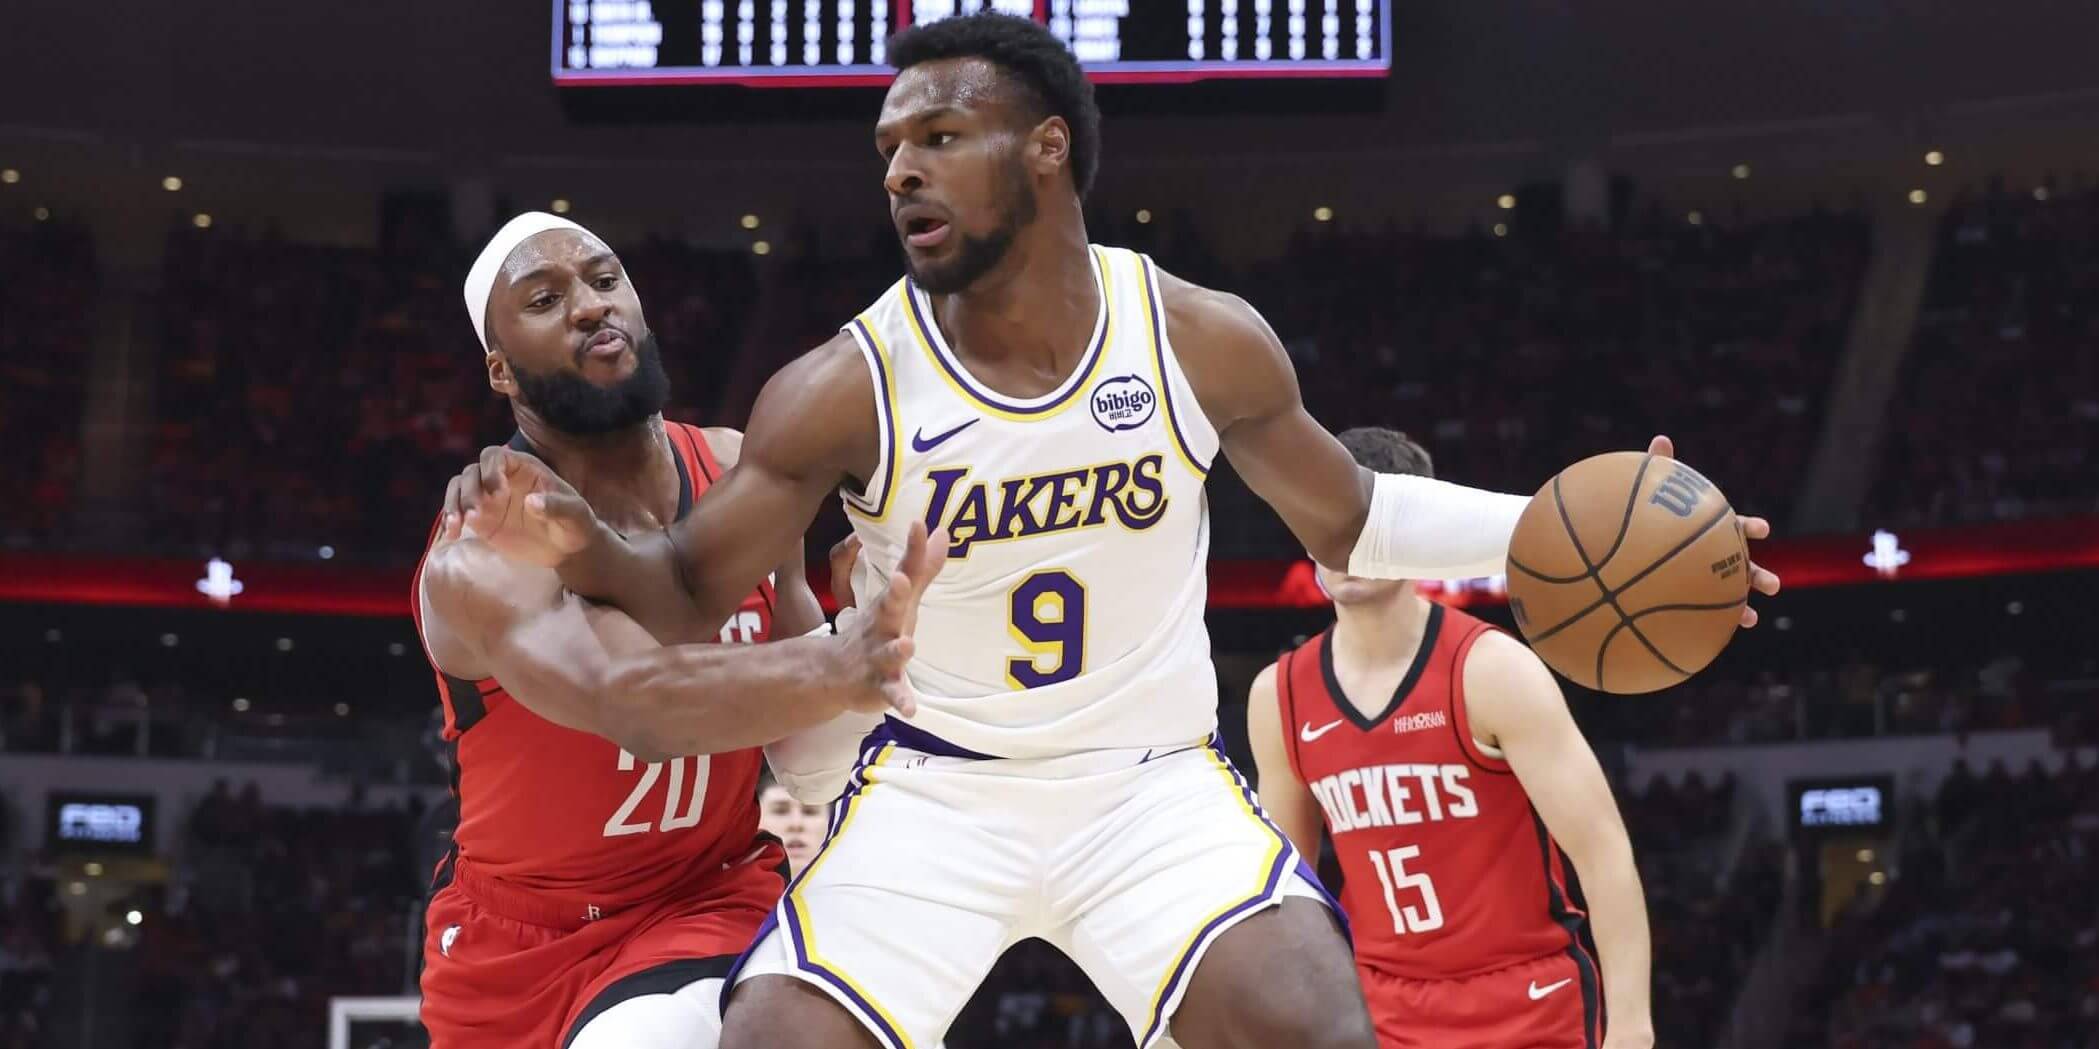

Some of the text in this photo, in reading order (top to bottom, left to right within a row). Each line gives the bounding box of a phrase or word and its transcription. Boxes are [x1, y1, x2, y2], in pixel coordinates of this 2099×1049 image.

[1096, 390, 1151, 413] bibigo
[924, 453, 1169, 560] LAKERS
[1006, 568, 1088, 690] 9
[603, 747, 711, 837] 20
[1367, 844, 1444, 935] 15
